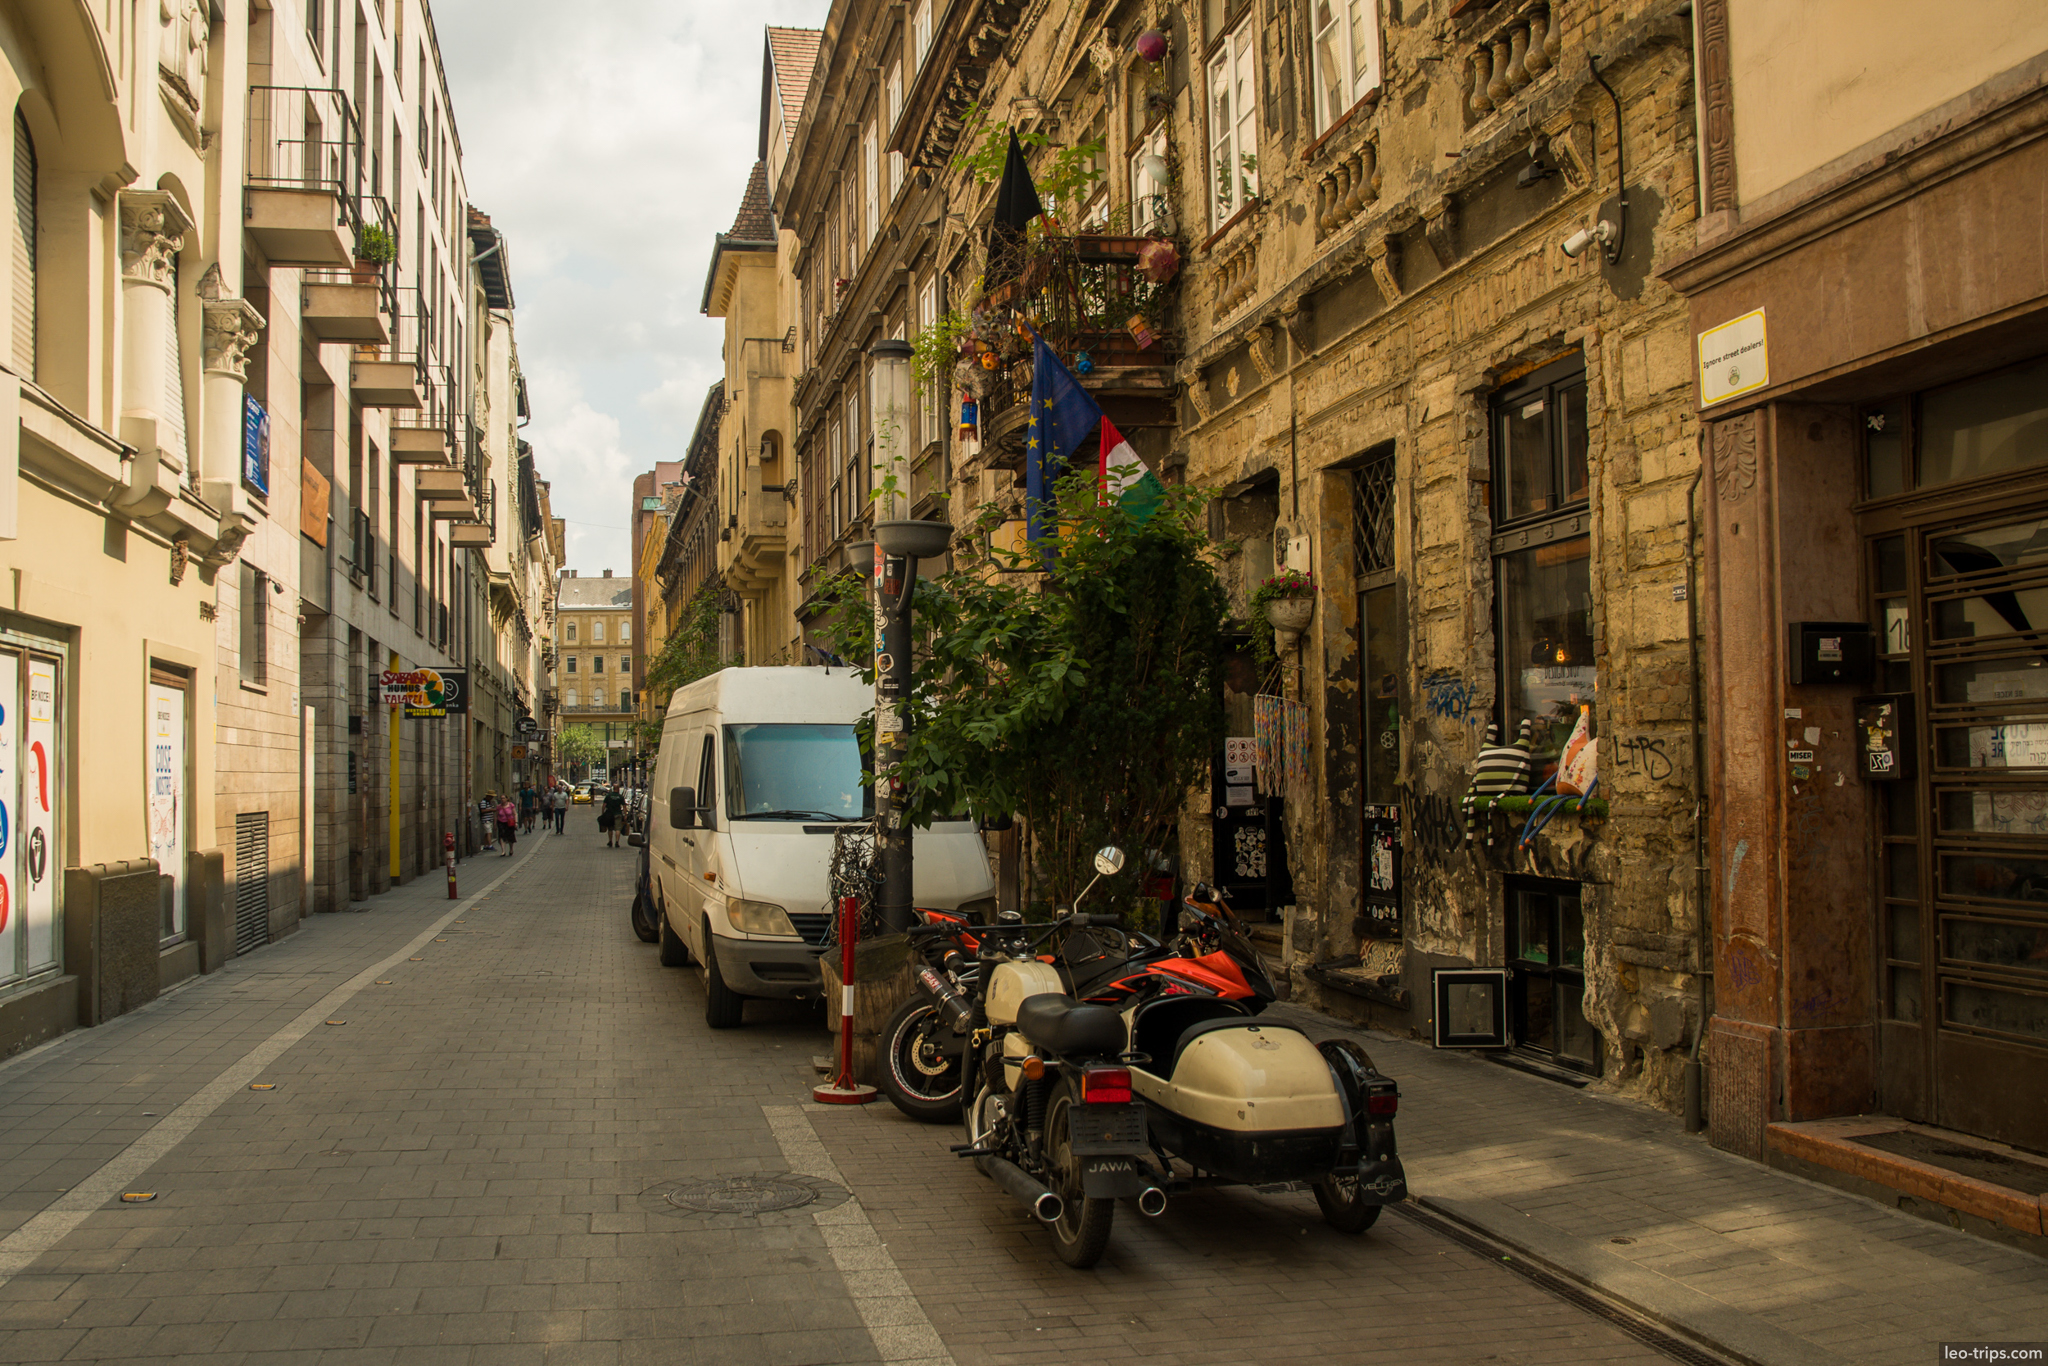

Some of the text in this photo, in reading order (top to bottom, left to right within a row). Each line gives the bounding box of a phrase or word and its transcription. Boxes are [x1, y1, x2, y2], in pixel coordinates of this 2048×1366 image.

[1703, 338, 1764, 369] Ignore street dealers!
[380, 670, 429, 686] SABABA
[387, 684, 421, 693] HUMUS
[31, 689, 38, 701] BE
[384, 694, 423, 704] FALAFEL
[156, 744, 171, 773] COSE
[1790, 752, 1812, 760] MISER
[1089, 1161, 1132, 1173] JAWA
